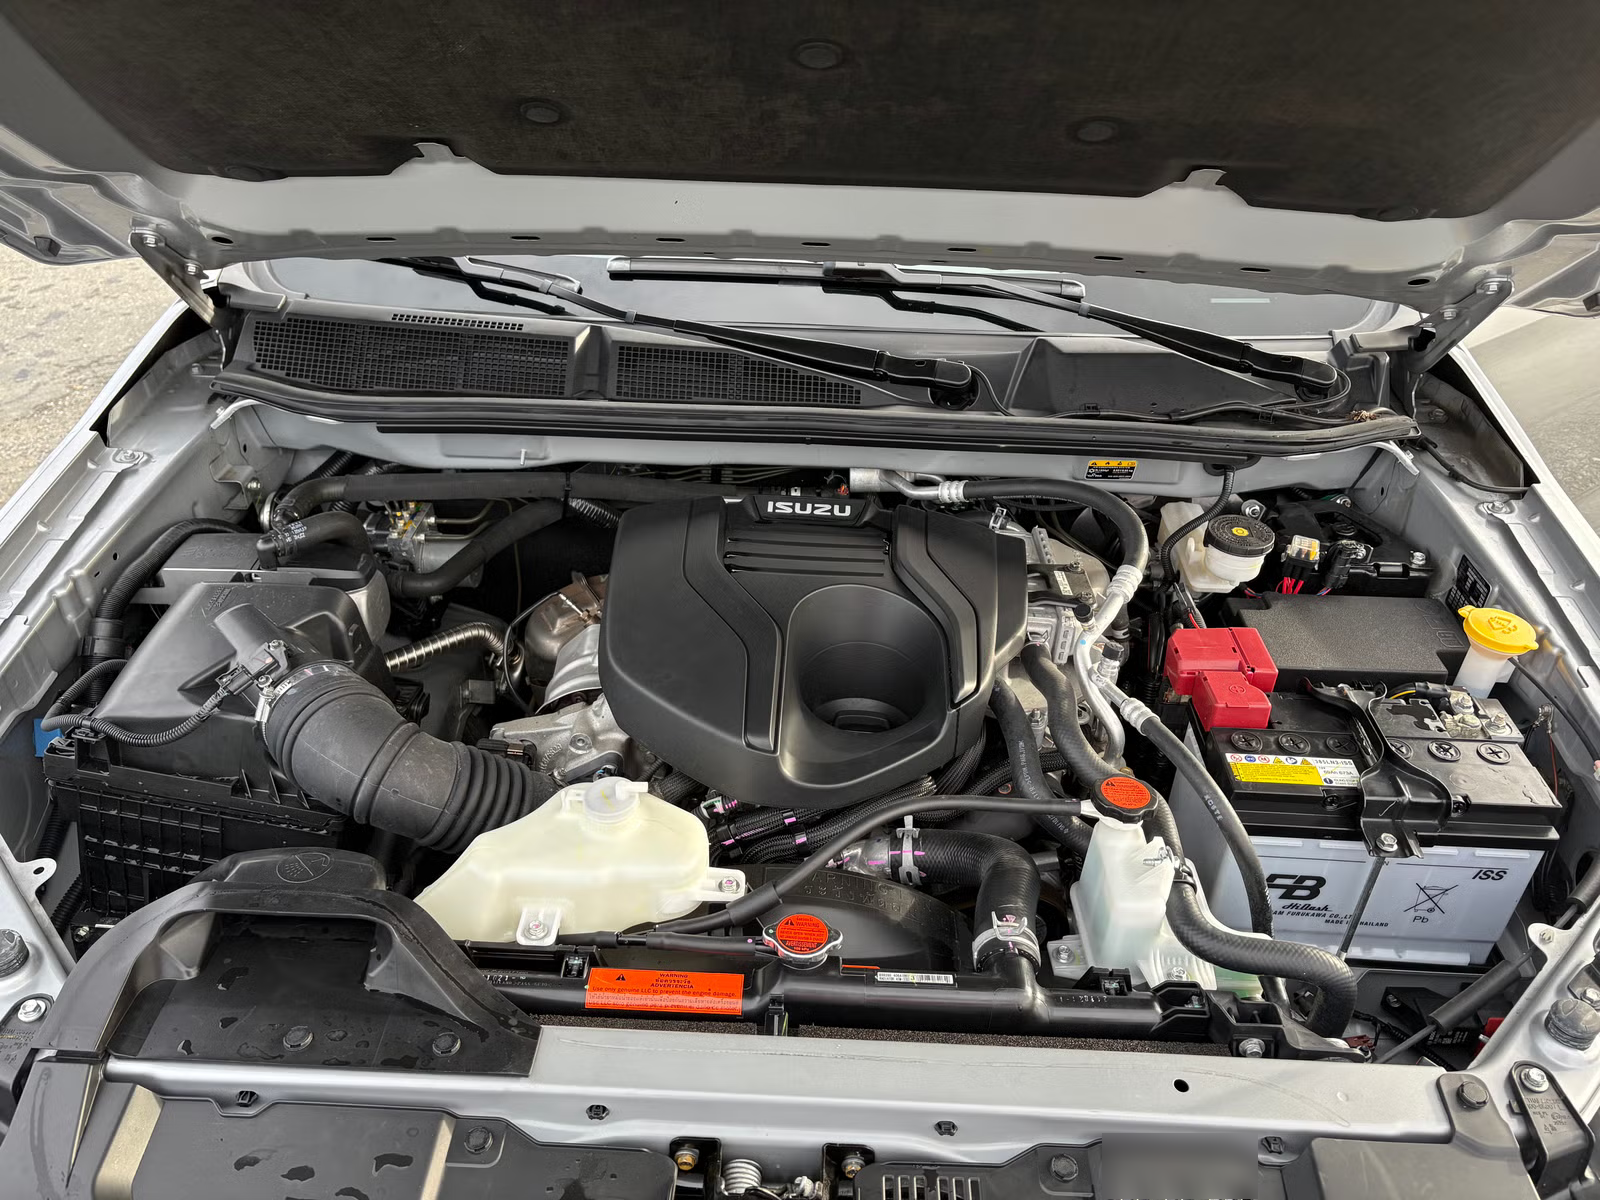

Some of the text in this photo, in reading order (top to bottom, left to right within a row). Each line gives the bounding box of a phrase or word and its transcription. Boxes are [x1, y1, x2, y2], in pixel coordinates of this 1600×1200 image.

[767, 501, 851, 517] ISUZU
[1471, 869, 1508, 880] ISS
[1265, 873, 1327, 901] FB
[1412, 915, 1429, 923] Pb
